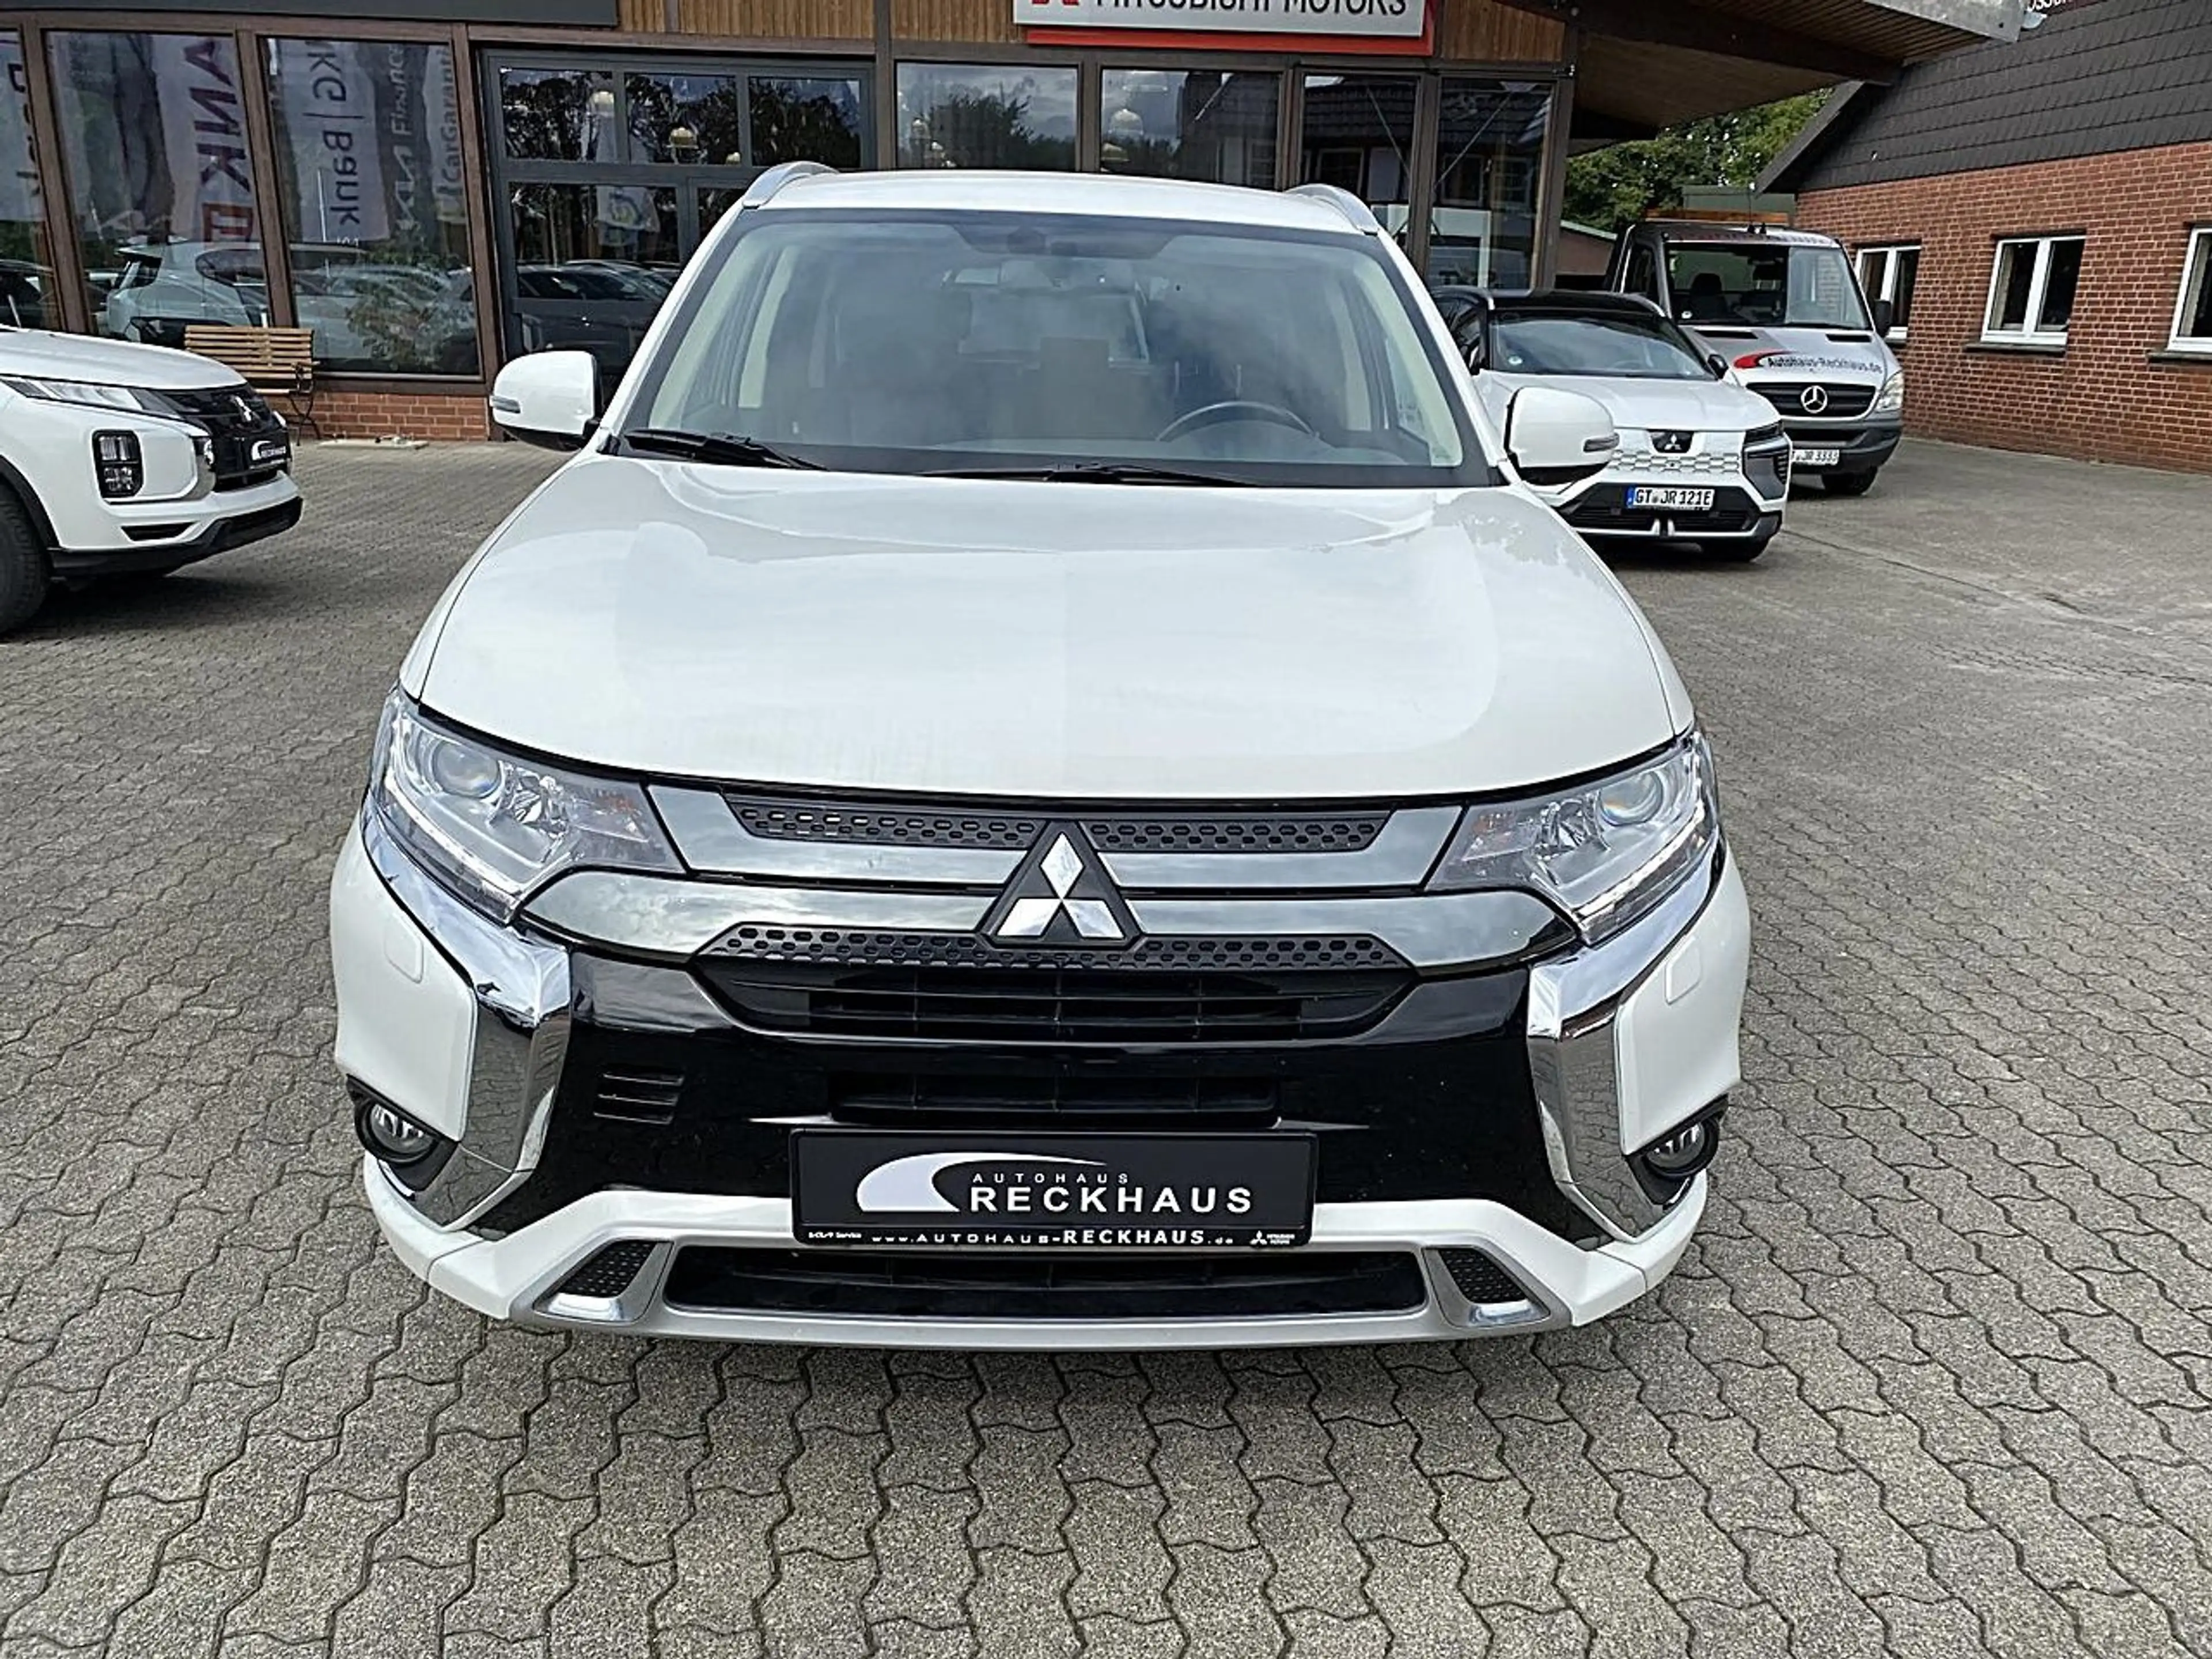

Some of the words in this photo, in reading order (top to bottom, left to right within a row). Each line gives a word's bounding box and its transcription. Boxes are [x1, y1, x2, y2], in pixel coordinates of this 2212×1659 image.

[1283, 0, 1406, 16] MOTORS
[1635, 489, 1653, 503] GT
[1660, 490, 1677, 504] JR
[1679, 490, 1712, 505] 121E
[972, 1173, 1128, 1184] AUTOHAUS
[971, 1186, 1252, 1213] RECKHAUS
